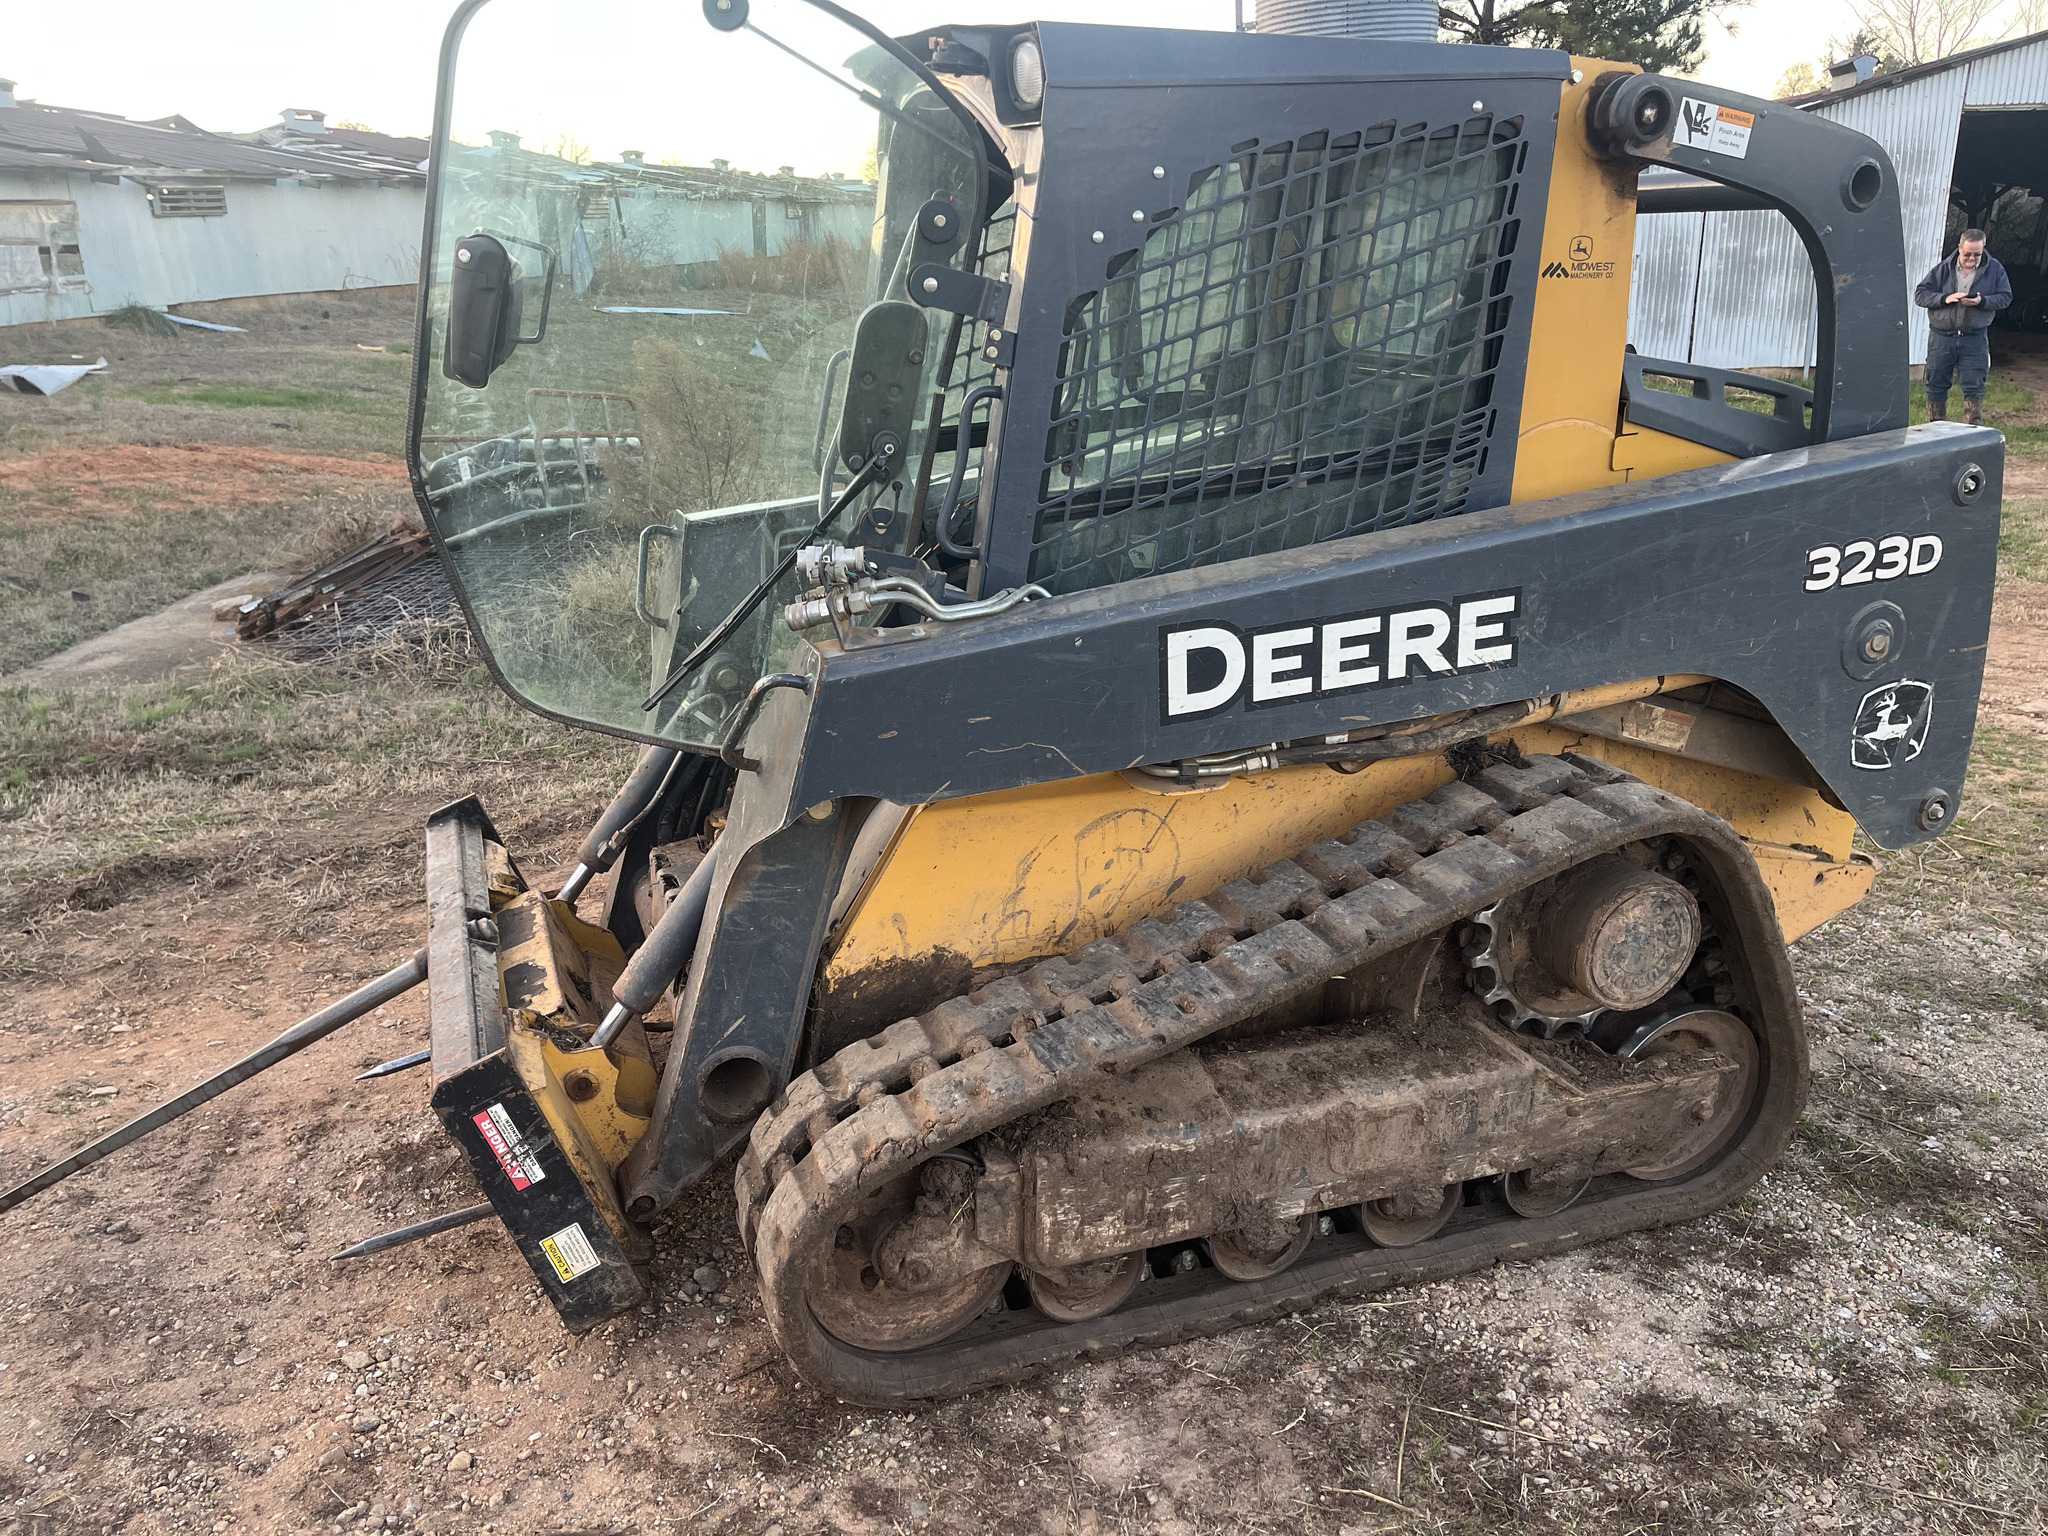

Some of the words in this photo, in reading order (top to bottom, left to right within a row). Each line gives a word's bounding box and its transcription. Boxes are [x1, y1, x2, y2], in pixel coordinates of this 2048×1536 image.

[1725, 111, 1751, 124] WARNING
[1718, 126, 1733, 136] Pinch
[1733, 130, 1745, 139] Area
[1718, 139, 1729, 147] Keep
[1729, 141, 1740, 149] Away
[1570, 261, 1616, 271] MIDWEST
[1569, 271, 1604, 279] MACHINERY
[1804, 535, 1943, 591] 323D
[1167, 595, 1516, 716] DEERE
[546, 1242, 566, 1268] CAUTION
